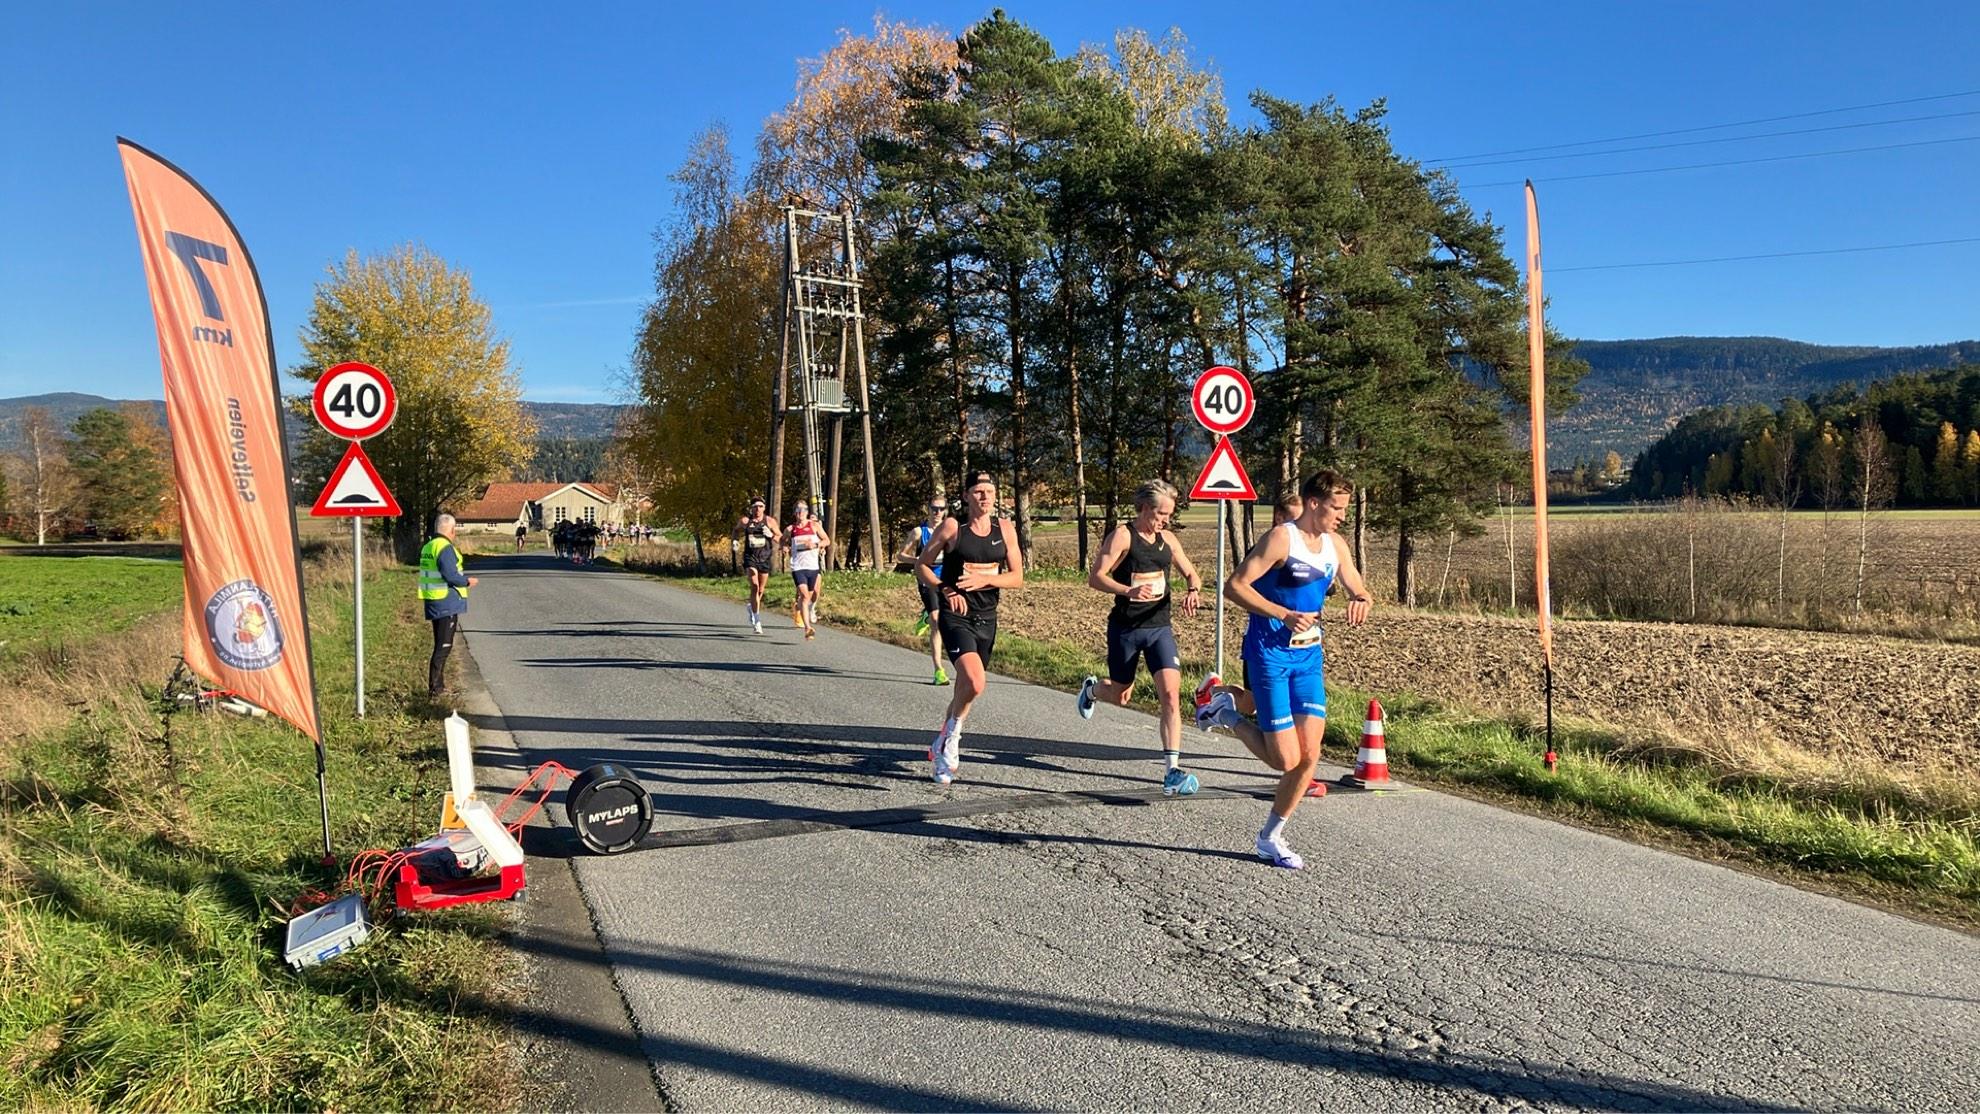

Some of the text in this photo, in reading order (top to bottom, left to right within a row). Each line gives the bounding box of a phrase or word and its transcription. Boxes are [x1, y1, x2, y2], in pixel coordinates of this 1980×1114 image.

[329, 383, 380, 418] 40
[1204, 385, 1242, 415] 40
[589, 804, 638, 824] MYLAPS
